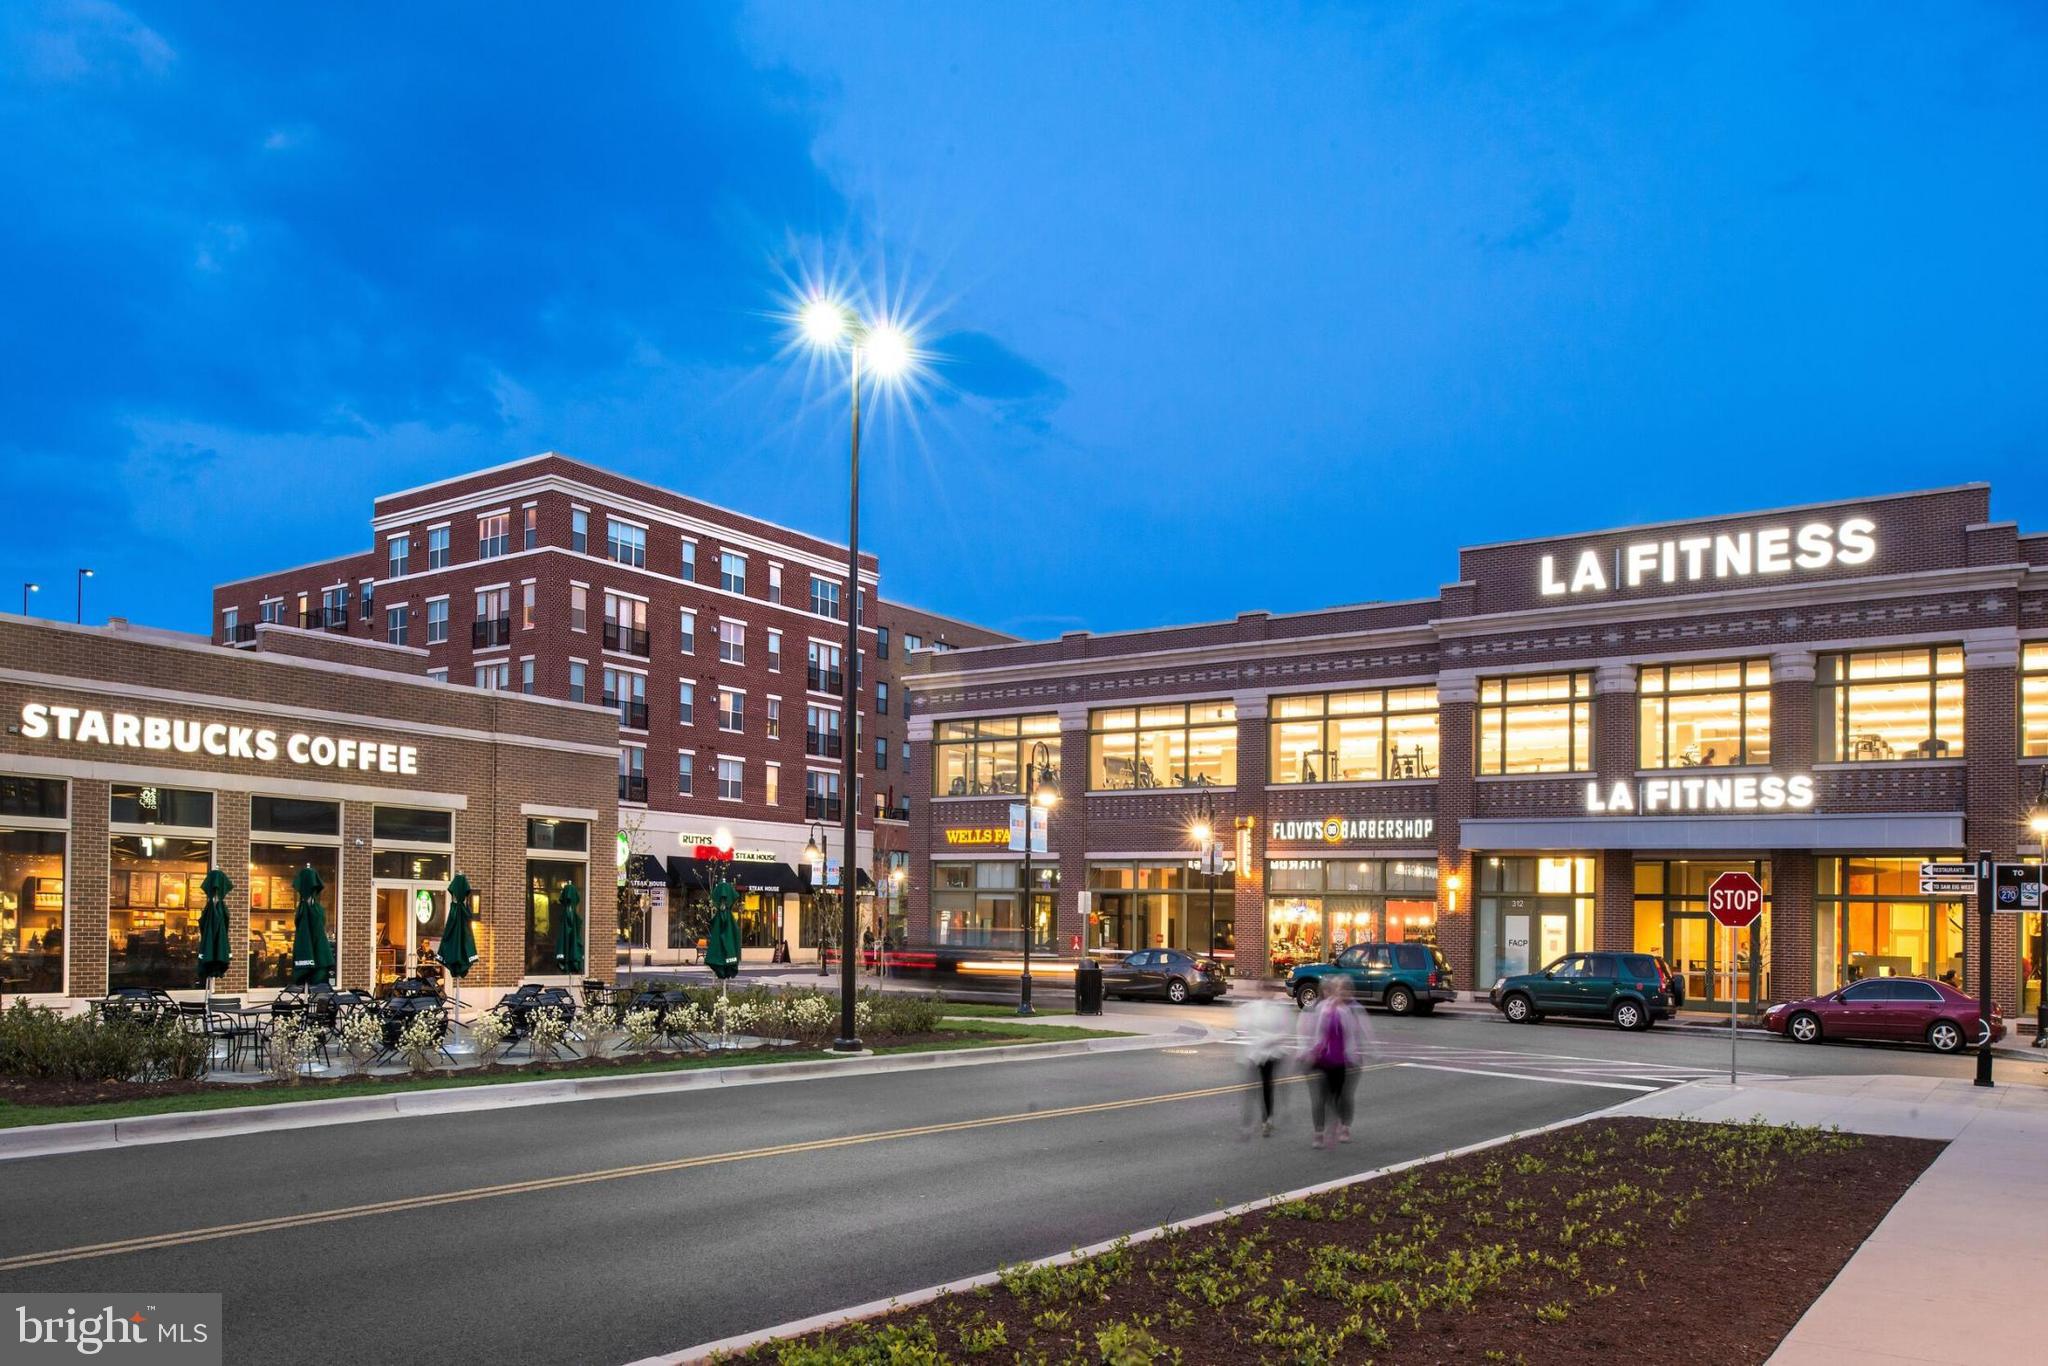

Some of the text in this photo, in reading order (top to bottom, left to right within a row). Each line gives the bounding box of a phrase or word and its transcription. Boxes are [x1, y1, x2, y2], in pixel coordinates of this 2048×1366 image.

[1541, 518, 1876, 596] LA FITNESS
[20, 703, 418, 775] STARBUCKS COFFEE
[1586, 776, 1814, 812] LA FITNESS
[945, 828, 992, 844] WELLS
[1272, 820, 1324, 840] FLOYD'S
[1341, 819, 1433, 839] BARBERSHOP
[682, 834, 712, 845] RUTH'S
[735, 852, 755, 860] STEAK
[756, 854, 777, 862] HOUSE
[2012, 869, 2025, 877] TO
[1712, 889, 1759, 910] STOP
[2001, 890, 2016, 899] 270
[1511, 900, 1524, 908] 312
[1508, 939, 1528, 947] FACP
